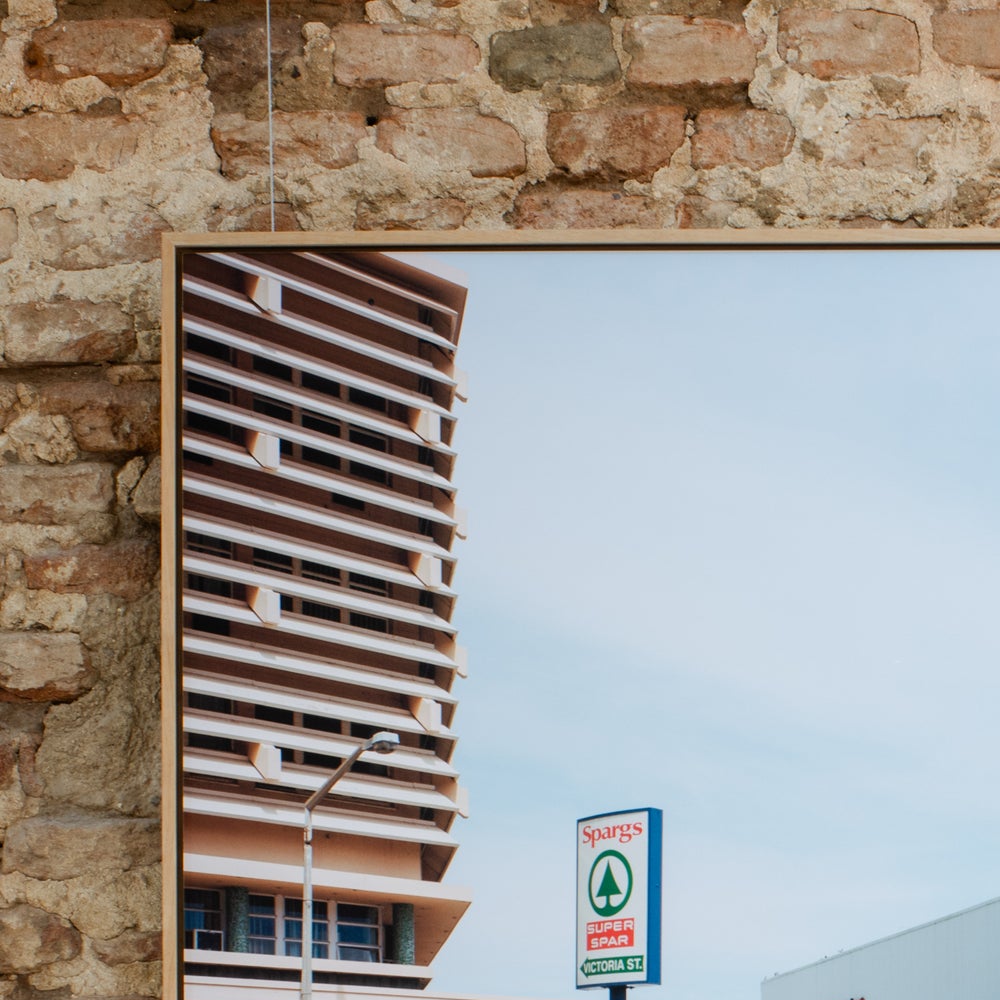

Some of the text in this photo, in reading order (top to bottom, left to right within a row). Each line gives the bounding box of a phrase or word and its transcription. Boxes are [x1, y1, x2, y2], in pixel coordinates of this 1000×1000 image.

[582, 821, 643, 848] Spargs
[586, 919, 634, 935] SUPER
[590, 934, 629, 949] SPAR
[583, 957, 643, 974] VICTORIA ST.
